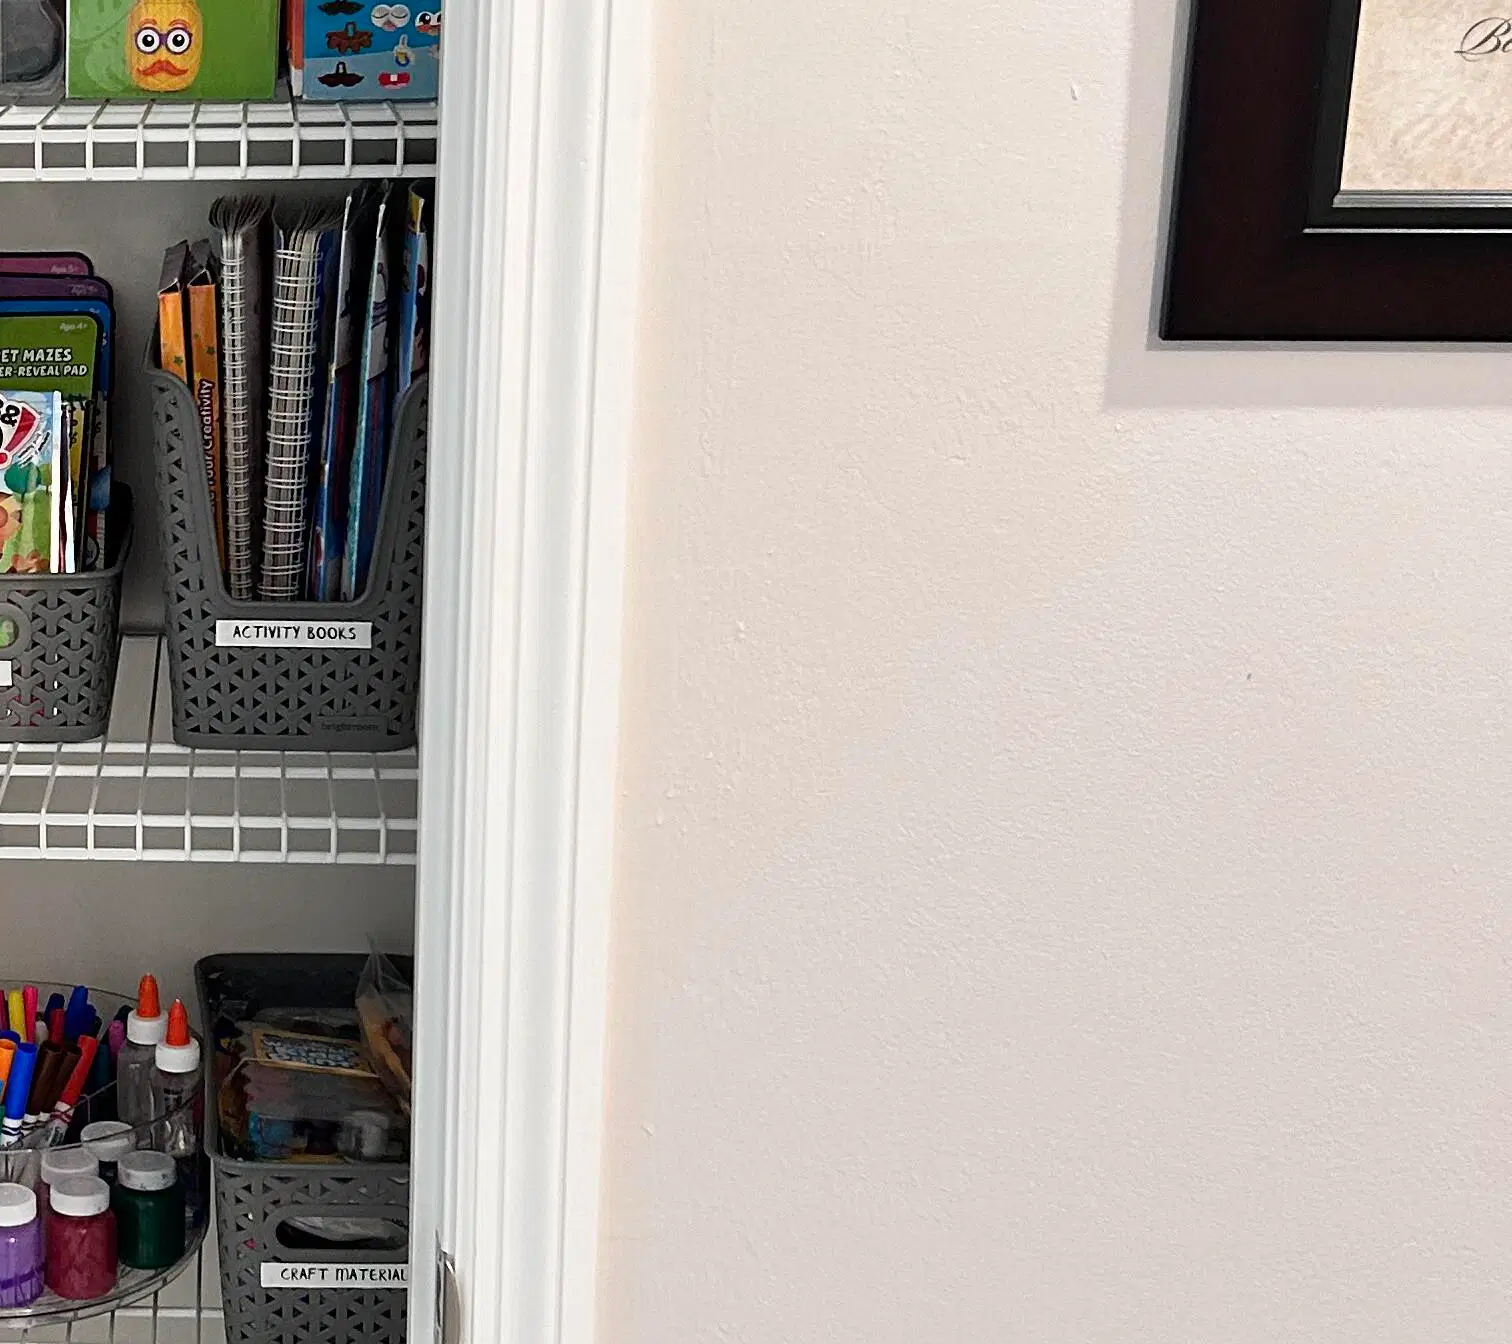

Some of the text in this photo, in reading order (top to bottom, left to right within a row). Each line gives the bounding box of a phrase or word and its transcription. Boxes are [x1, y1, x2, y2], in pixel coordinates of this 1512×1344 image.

[22, 348, 73, 363] MAZES
[63, 365, 88, 376] PAD
[198, 380, 214, 449] Creativity
[233, 625, 357, 640] ACTIVITY BOOKS
[280, 1268, 329, 1281] CRAFT
